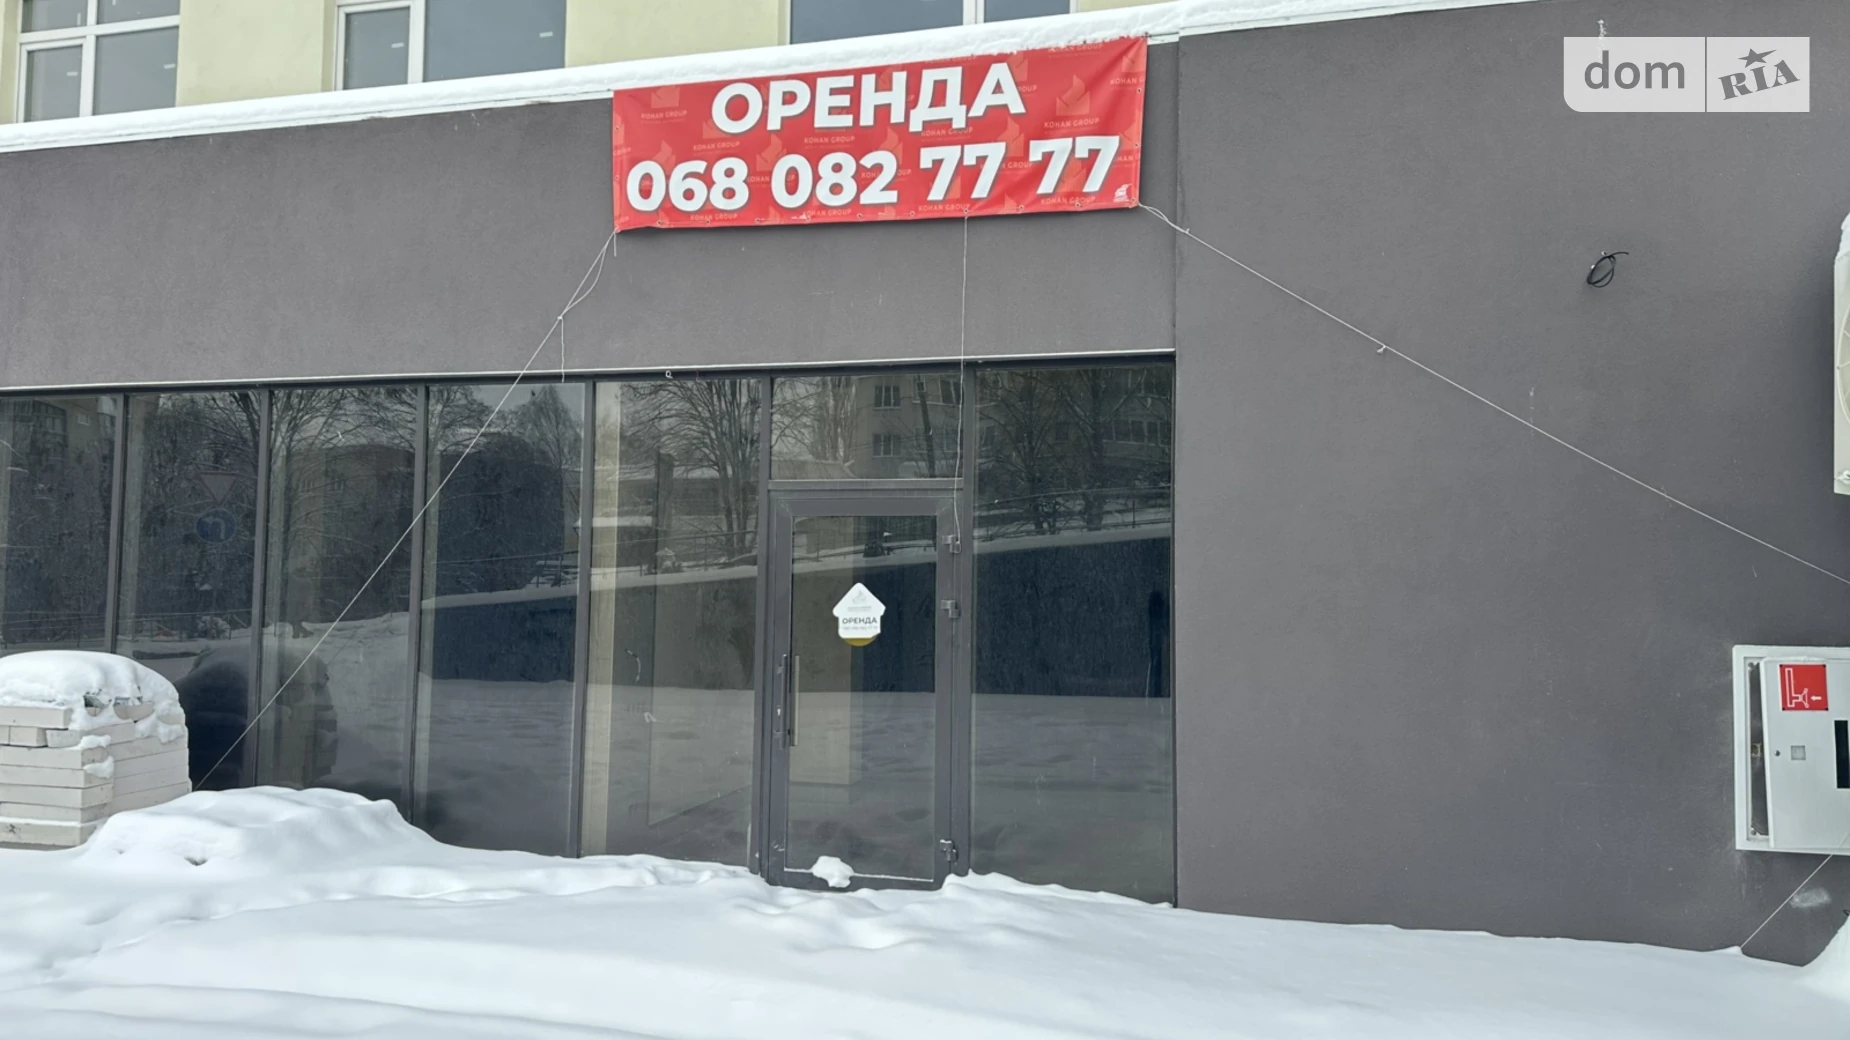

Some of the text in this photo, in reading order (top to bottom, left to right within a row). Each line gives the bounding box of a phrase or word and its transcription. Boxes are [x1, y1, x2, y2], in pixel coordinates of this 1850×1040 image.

[711, 62, 1027, 134] ОРЕНДА
[1043, 118, 1100, 129] KOHAN GROUP
[831, 135, 856, 143] GROUP
[626, 135, 1120, 212] 068 082 77 77
[946, 203, 971, 211] GROUP
[828, 209, 852, 217] GROUP
[842, 616, 878, 625] ОРЕНДА
